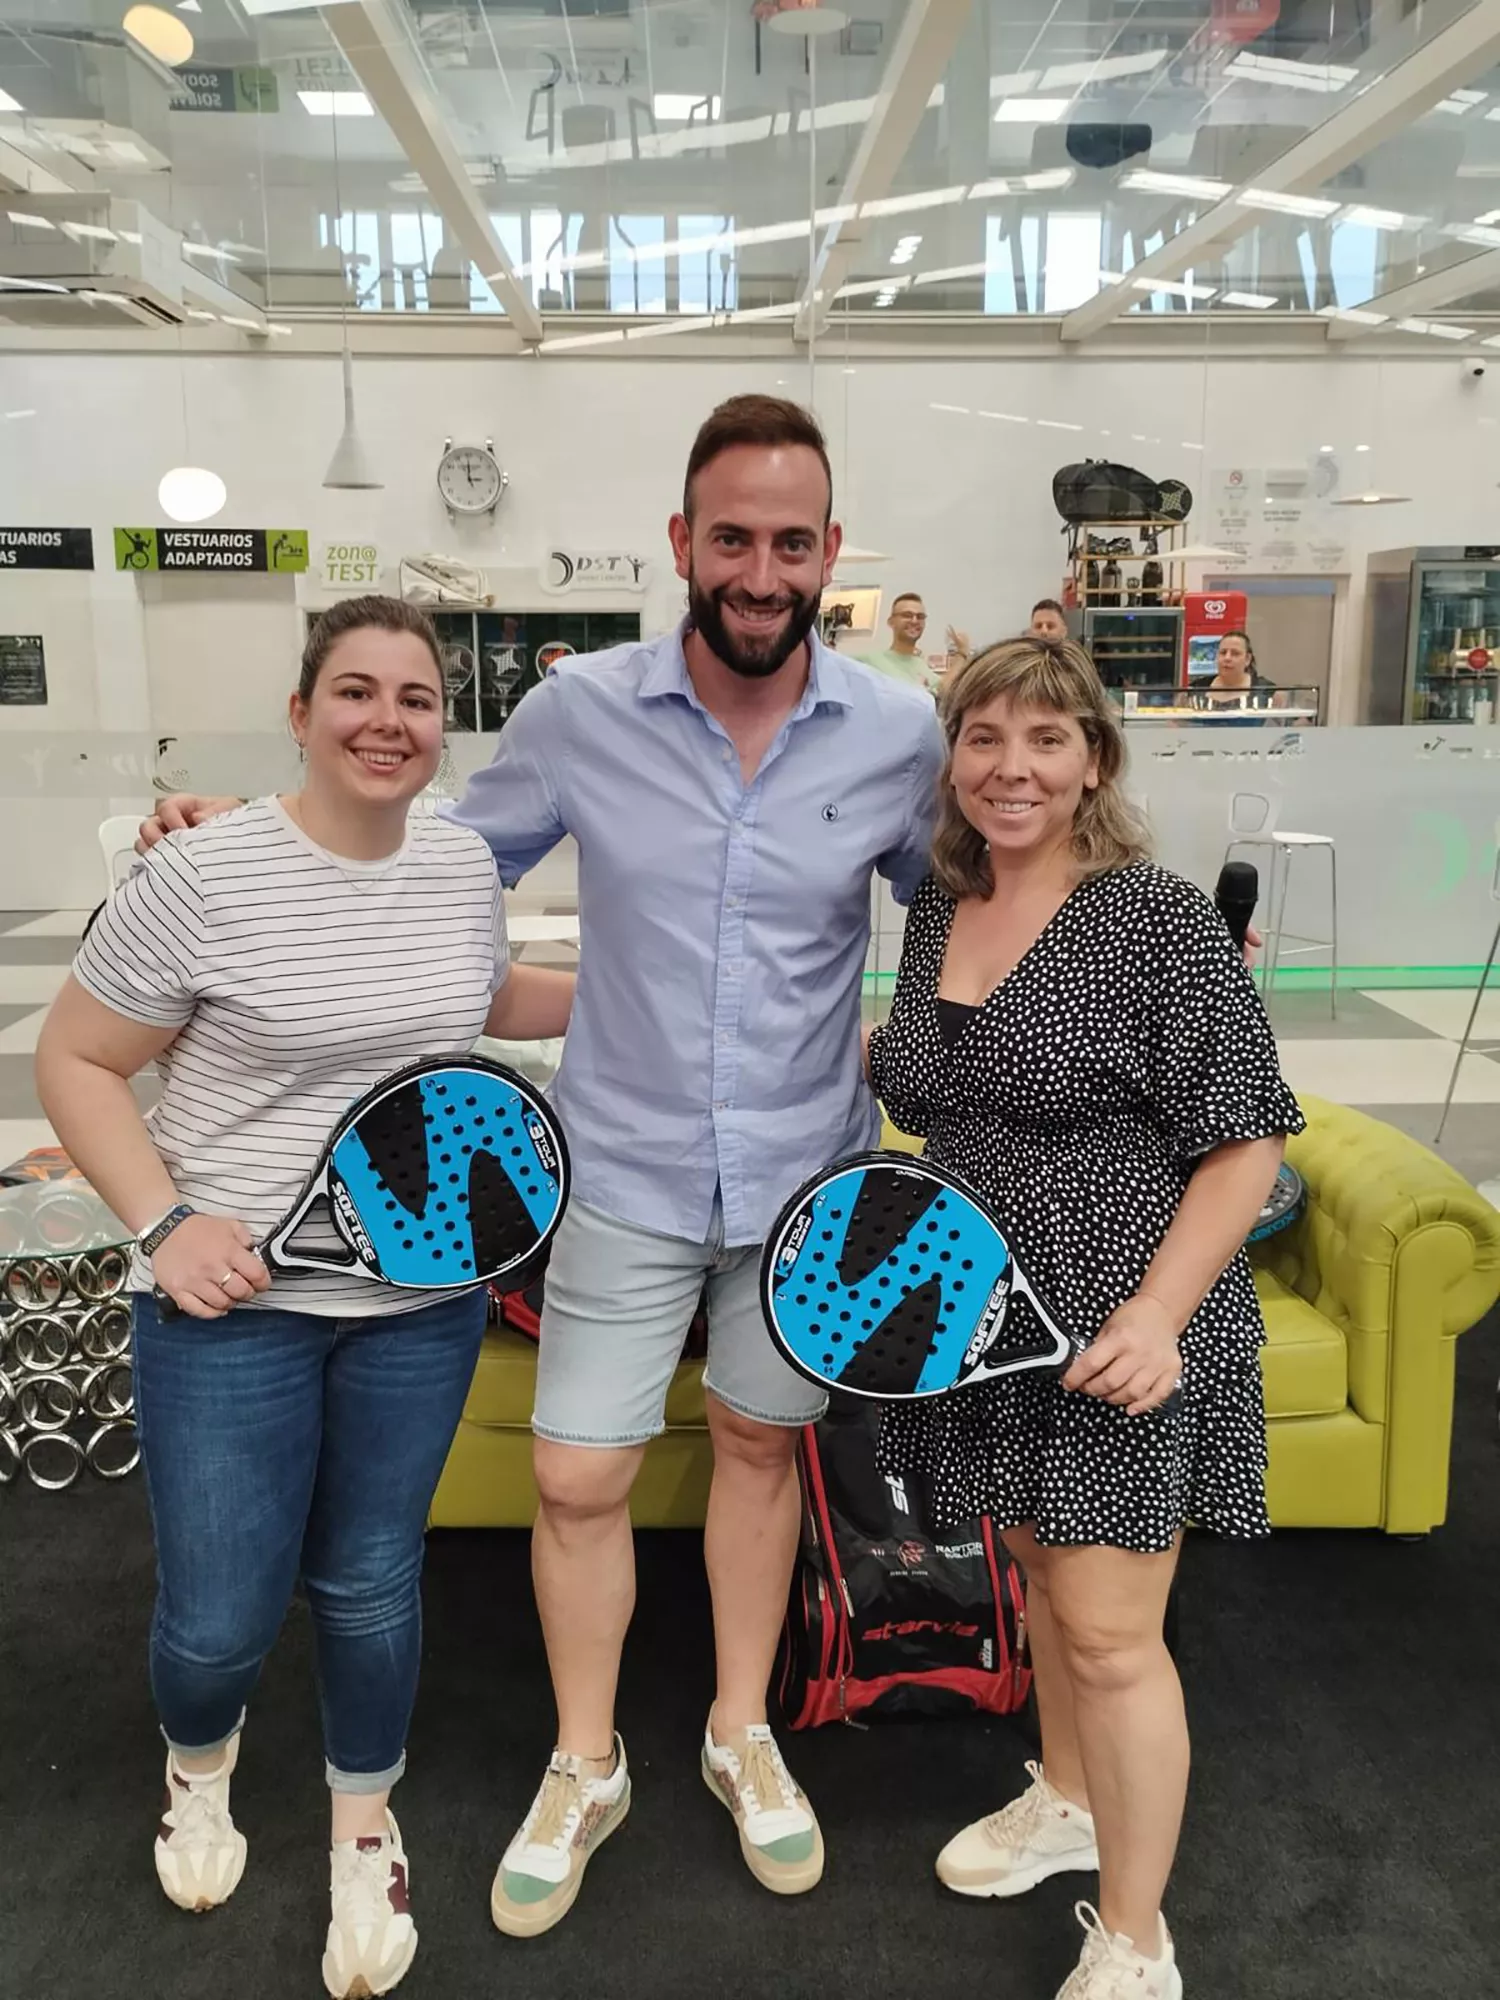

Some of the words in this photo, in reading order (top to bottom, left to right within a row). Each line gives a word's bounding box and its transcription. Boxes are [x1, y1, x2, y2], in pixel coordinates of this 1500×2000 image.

[164, 533, 253, 548] VESTUARIOS
[327, 546, 377, 560] zon@
[164, 552, 252, 566] ADAPTADOS
[326, 564, 378, 582] TEST
[540, 1136, 557, 1168] TOUR
[331, 1181, 377, 1262] SOFTEE
[787, 1213, 807, 1247] TOUR
[964, 1279, 1010, 1367] SOFTEE
